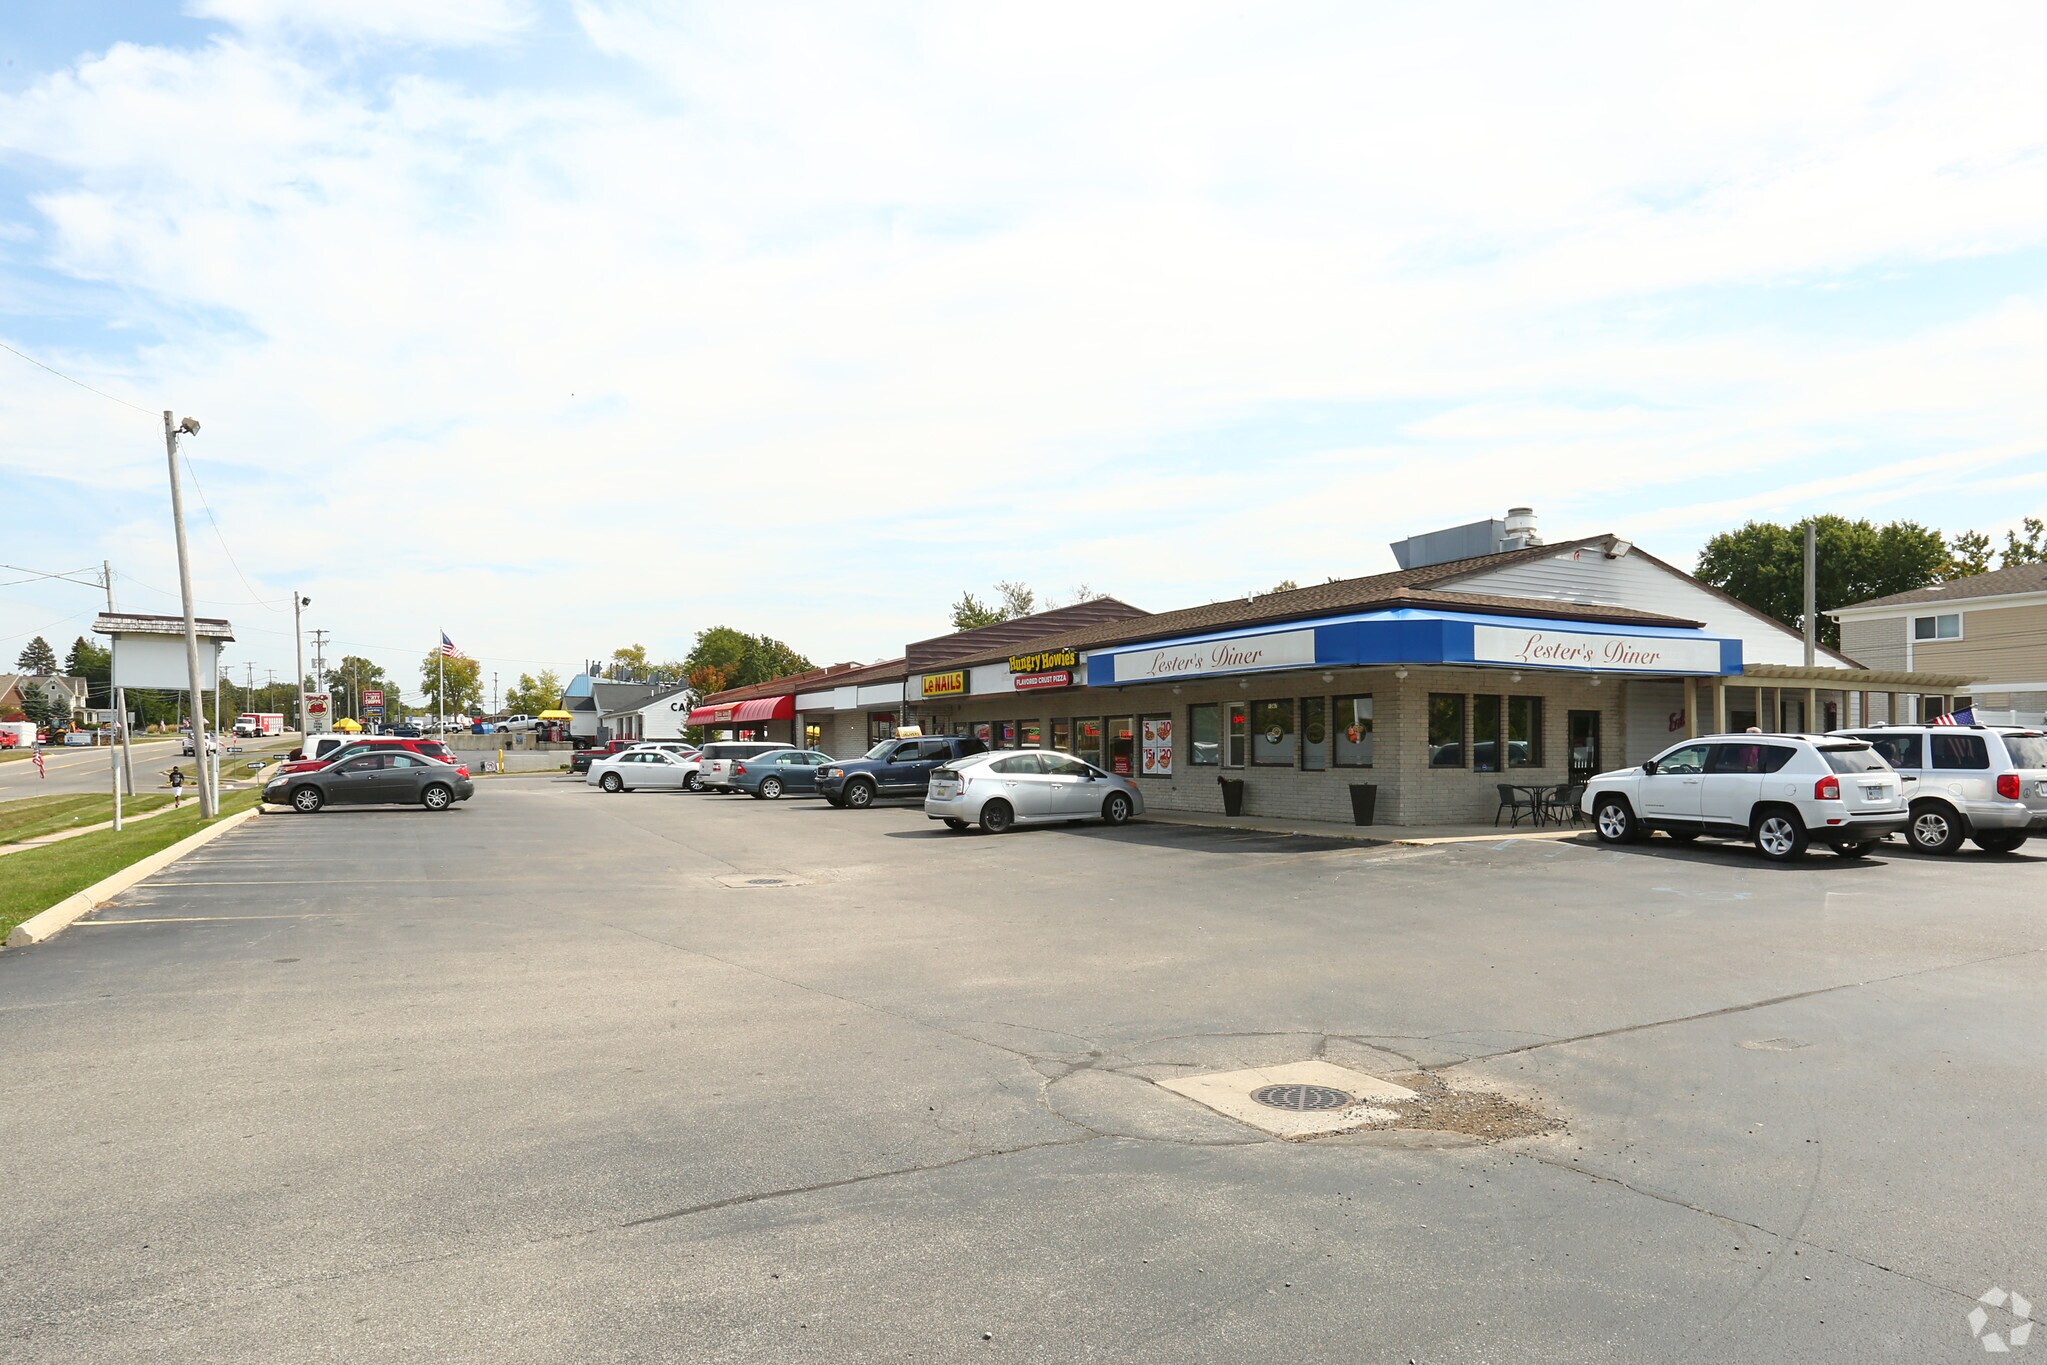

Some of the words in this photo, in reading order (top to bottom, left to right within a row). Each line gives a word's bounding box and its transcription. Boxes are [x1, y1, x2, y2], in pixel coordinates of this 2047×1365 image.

[1009, 655, 1041, 671] Hungry
[1041, 649, 1076, 669] Howie's
[1146, 651, 1203, 677] Lester's
[1211, 643, 1263, 668] Diner
[1515, 633, 1594, 663] Lester's
[1603, 639, 1661, 665] Diner
[923, 677, 934, 693] Le
[935, 673, 962, 692] NAILS
[1016, 677, 1038, 686] FLAVORED
[1038, 675, 1053, 684] CRUST
[1052, 674, 1067, 683] PIZZA
